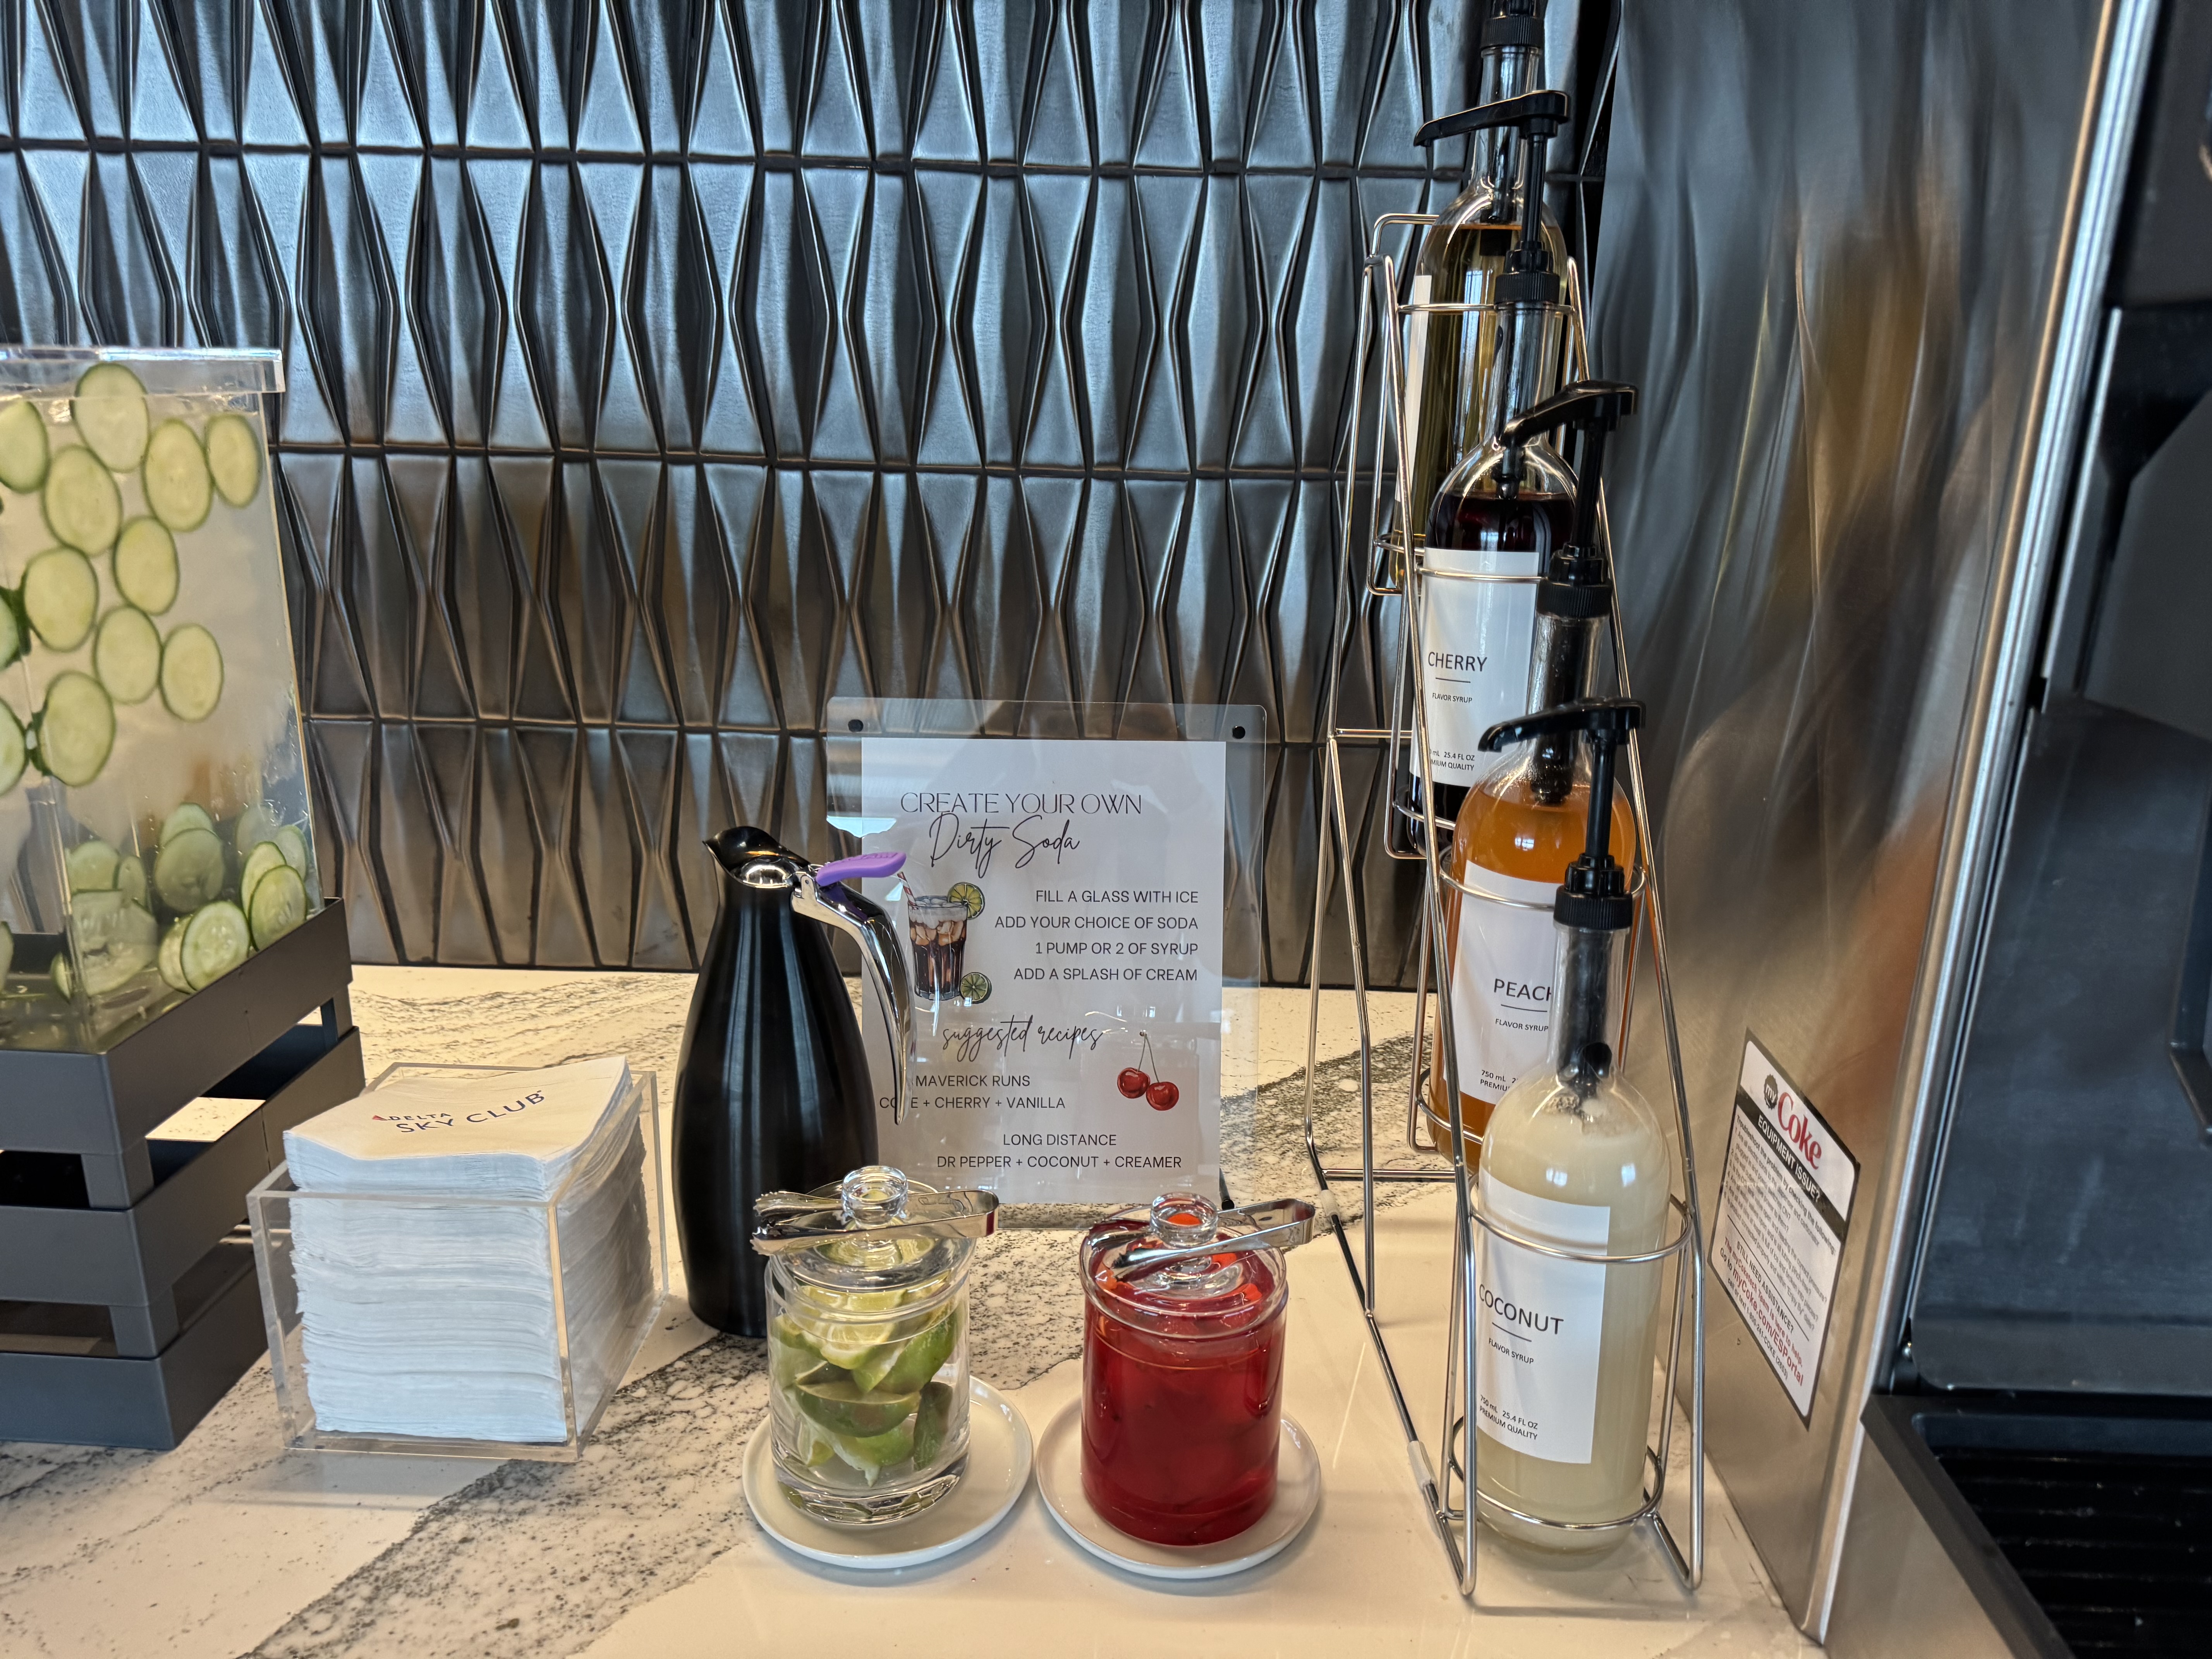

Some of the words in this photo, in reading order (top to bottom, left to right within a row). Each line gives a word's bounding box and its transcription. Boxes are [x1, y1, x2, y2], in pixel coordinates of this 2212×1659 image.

[1429, 652, 1487, 672] CHERRY
[1432, 693, 1451, 701] FLAVOR
[1448, 763, 1474, 771] QUALITY
[901, 792, 1000, 813] CREATE
[1006, 793, 1074, 813] YOUR
[1081, 794, 1140, 814] OWN
[930, 812, 1010, 878] Dirty
[1012, 815, 1080, 869] Soda
[1037, 890, 1063, 902] FILL
[1068, 891, 1077, 902] A
[1082, 891, 1129, 902] GLASS
[1133, 891, 1171, 902] WITH
[1176, 891, 1198, 903] ICE
[995, 916, 1025, 927] ADD
[1030, 917, 1070, 928] YOUR
[1075, 917, 1130, 928] CHOICE
[1135, 917, 1153, 929] OF
[1158, 917, 1198, 929] SODA
[1036, 943, 1042, 953] 1
[1047, 943, 1087, 954] PUMP
[1092, 943, 1111, 954] OR
[1116, 943, 1123, 954] 2
[1128, 943, 1147, 954] OF
[1151, 943, 1198, 955] SYRUP
[1014, 968, 1044, 979] ADD
[1049, 969, 1058, 979] A
[1063, 969, 1118, 980] SPLASH
[1123, 969, 1142, 980] OF
[1146, 969, 1197, 981] CREAM
[1496, 1018, 1523, 1029] FLAVOR
[943, 1015, 1034, 1062] suggested
[1037, 1025, 1104, 1059] recipes
[916, 1075, 987, 1086] MAVERICK
[993, 1075, 1030, 1086] RUNS
[1482, 1070, 1493, 1078] 750
[1480, 1079, 1510, 1091] PREMIU
[396, 1119, 454, 1132] SKY
[466, 1092, 544, 1122] CLUB
[880, 1097, 918, 1108] CE
[935, 1097, 990, 1108] CHERRY
[1007, 1097, 1065, 1108] VANILLA
[1765, 1084, 1776, 1103] my
[1778, 1092, 1822, 1170] Coke
[1004, 1134, 1042, 1145] LONG
[1047, 1134, 1116, 1145] DISTANCE
[938, 1156, 955, 1167] DR
[960, 1156, 1011, 1167] PEPPER
[1028, 1156, 1099, 1167] COCONUT
[1115, 1156, 1181, 1168] CREAMER
[1758, 1115, 1796, 1169] EQUIPMENT
[1795, 1163, 1820, 1202] ISSUE?
[1737, 1114, 1760, 1151] Troubleshoot
[1766, 1156, 1783, 1182] problem
[1783, 1177, 1789, 1191] by
[1789, 1187, 1807, 1217] checking
[1815, 1221, 1835, 1255] following:
[1736, 1240, 1748, 1264] STILL
[1749, 1260, 1762, 1283] NEED
[1762, 1281, 1794, 1334] ASSISTANCE?
[1479, 1284, 1564, 1334] COCONUT
[1720, 1247, 1727, 1262] Go
[1727, 1259, 1732, 1271] to
[1733, 1266, 1803, 1386] myCoke.com/ESPortal
[1732, 1250, 1757, 1293] myCoketech
[1758, 1288, 1769, 1313] Team
[1770, 1309, 1774, 1321] is
[1775, 1317, 1785, 1338] here
[1786, 1334, 1791, 1347] to
[1791, 1343, 1802, 1368] help.
[1489, 1338, 1510, 1356] FLAVOR
[1511, 1351, 1534, 1364] SYRUP
[1490, 1404, 1498, 1413] mL
[1503, 1410, 1516, 1422] 25.4
[1480, 1406, 1505, 1428] PREMIUM
[1508, 1424, 1537, 1440] QUALITY
